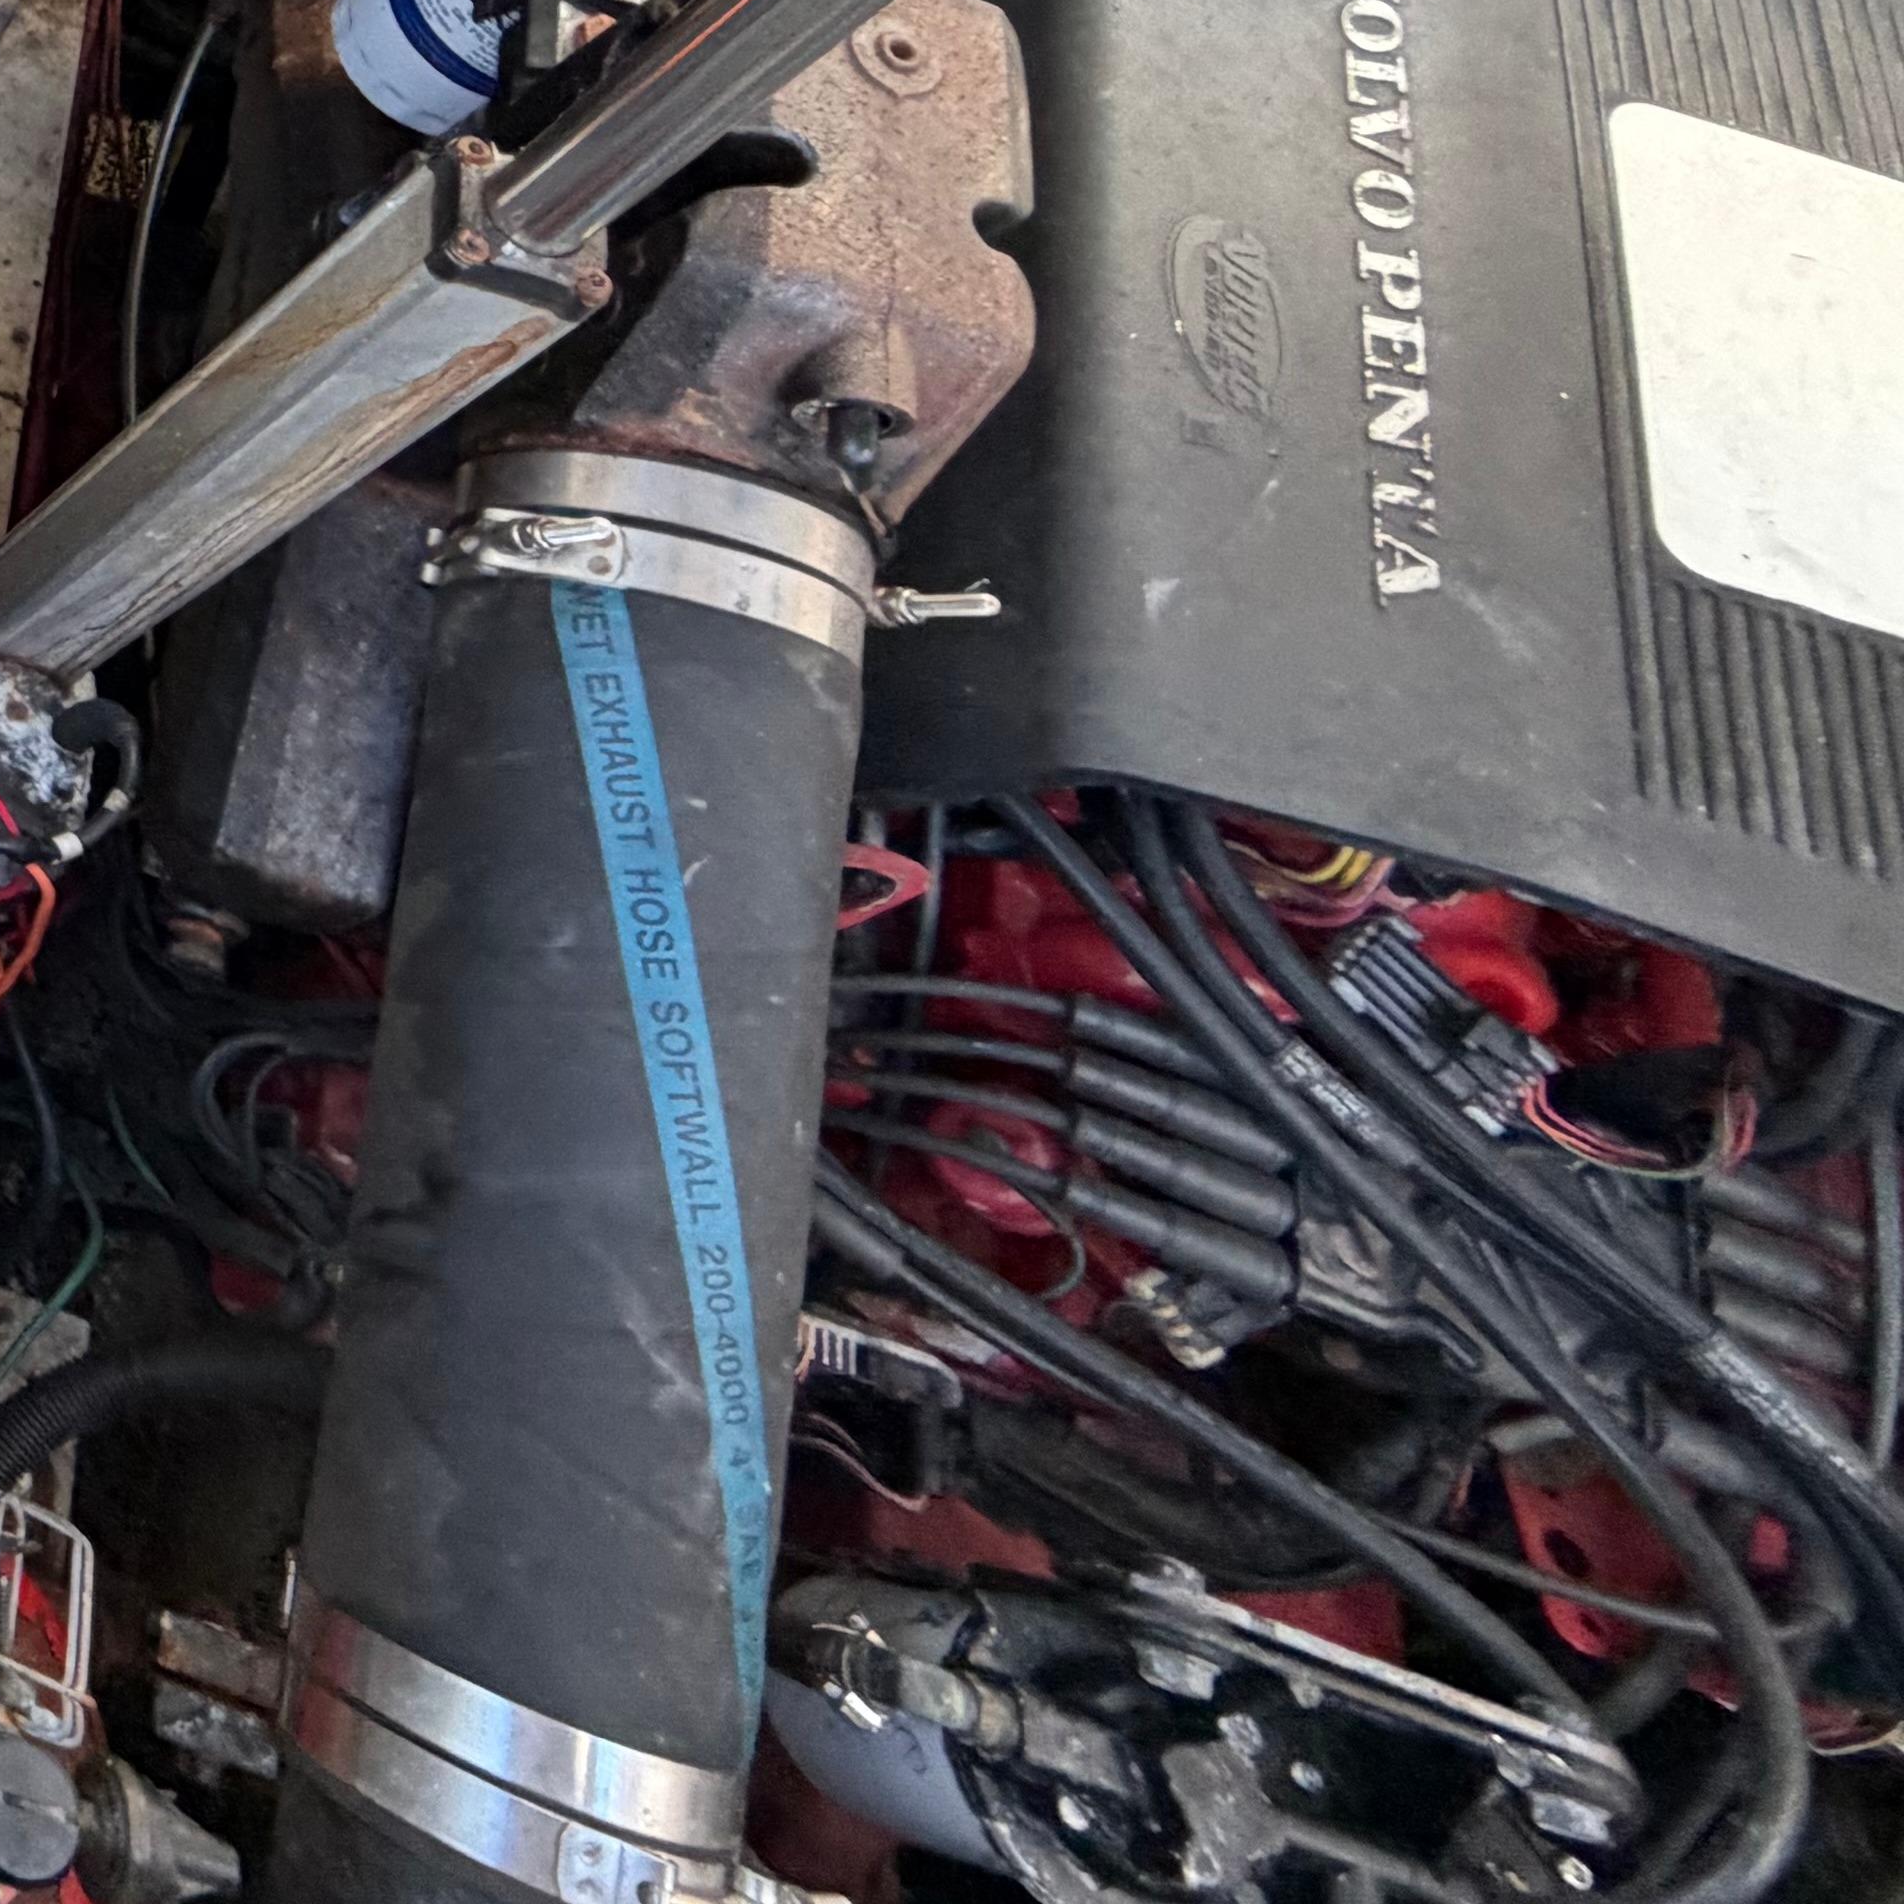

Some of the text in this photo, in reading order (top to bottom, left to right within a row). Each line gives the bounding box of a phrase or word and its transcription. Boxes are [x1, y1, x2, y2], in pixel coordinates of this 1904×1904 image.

[1355, 240, 1442, 611] PENTA
[565, 583, 615, 655] WET
[584, 672, 658, 850] EXHAUST
[624, 868, 681, 981] HOSE
[648, 1000, 723, 1226] SOFTWALL
[697, 1245, 749, 1427] 200-4000
